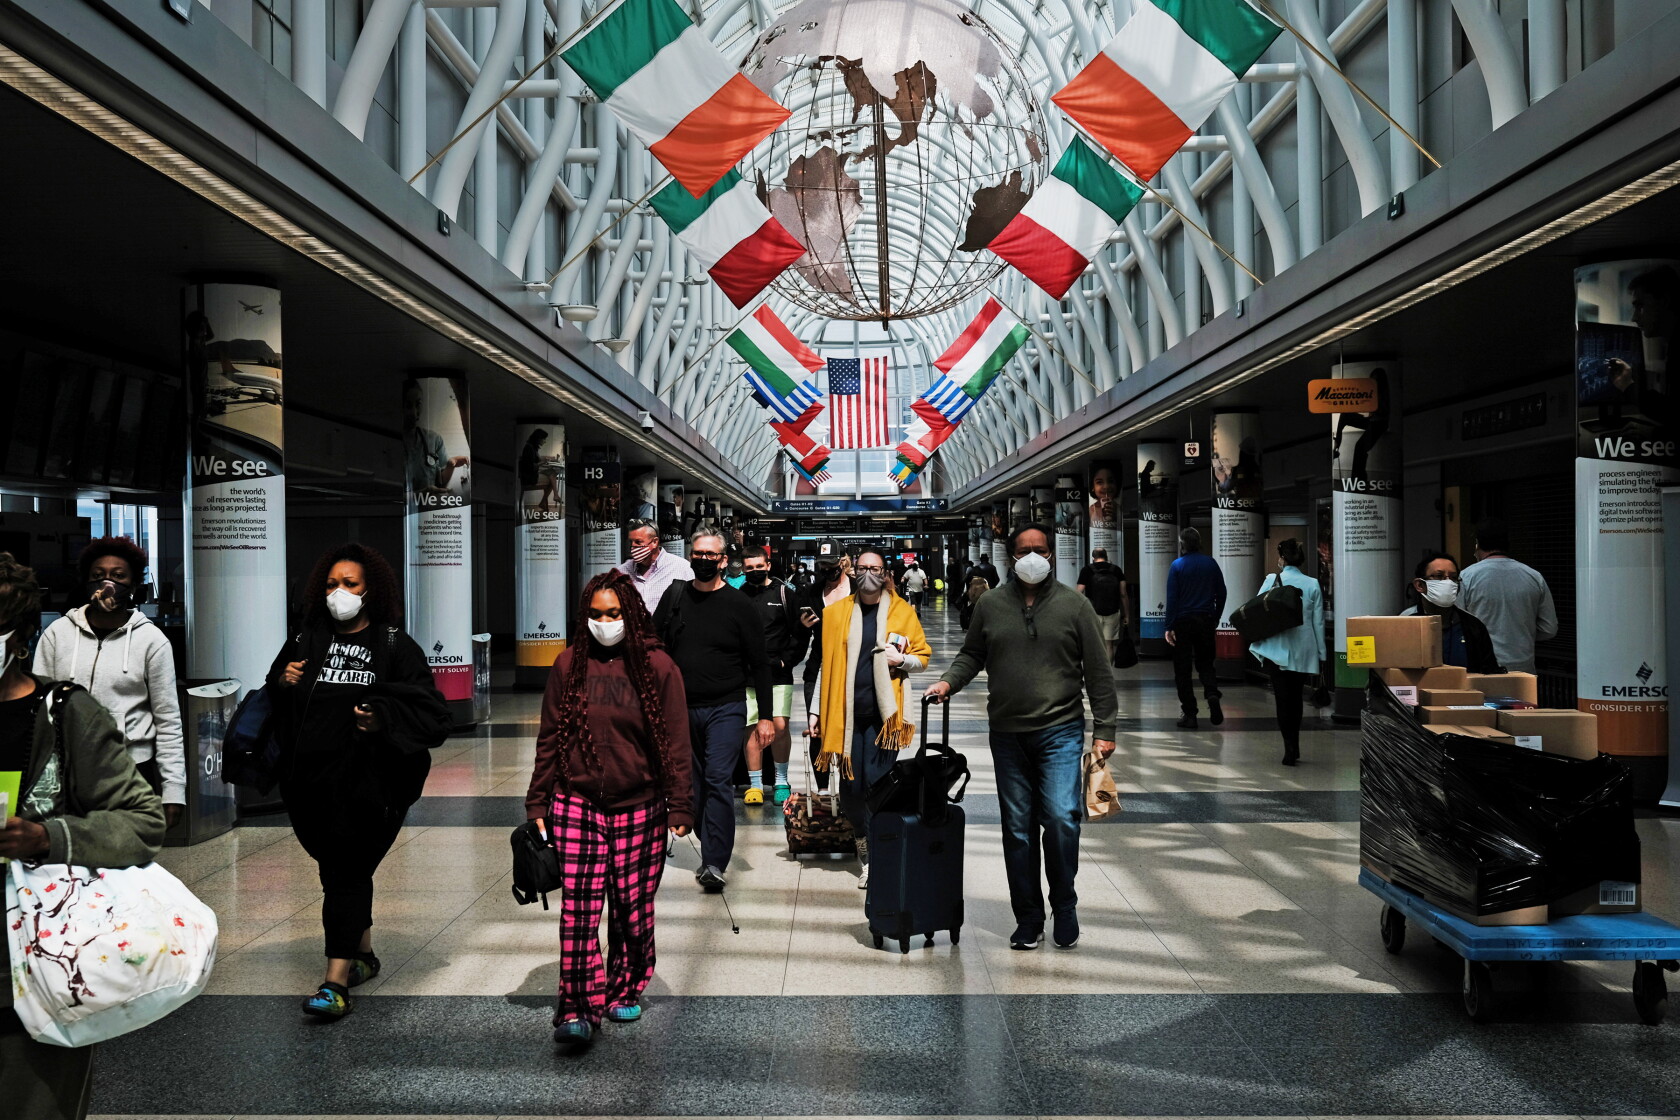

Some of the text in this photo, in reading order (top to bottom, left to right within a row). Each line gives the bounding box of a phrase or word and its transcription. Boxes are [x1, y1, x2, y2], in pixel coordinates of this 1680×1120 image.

[1315, 387, 1373, 400] Macaroni
[1595, 437, 1675, 458] We see
[193, 456, 267, 476] We see
[584, 467, 603, 479] H3
[1342, 477, 1392, 491] We see
[414, 492, 462, 506] We see
[1066, 490, 1080, 499] K2
[245, 496, 266, 505] lasting
[1217, 498, 1255, 508] We see
[235, 505, 267, 513] projected.
[522, 509, 559, 519] We see
[1143, 512, 1157, 520] We
[330, 655, 346, 668] OF
[1602, 686, 1668, 697] EMERSO
[1590, 704, 1642, 712] CONSIDER
[205, 752, 222, 775] O'H
